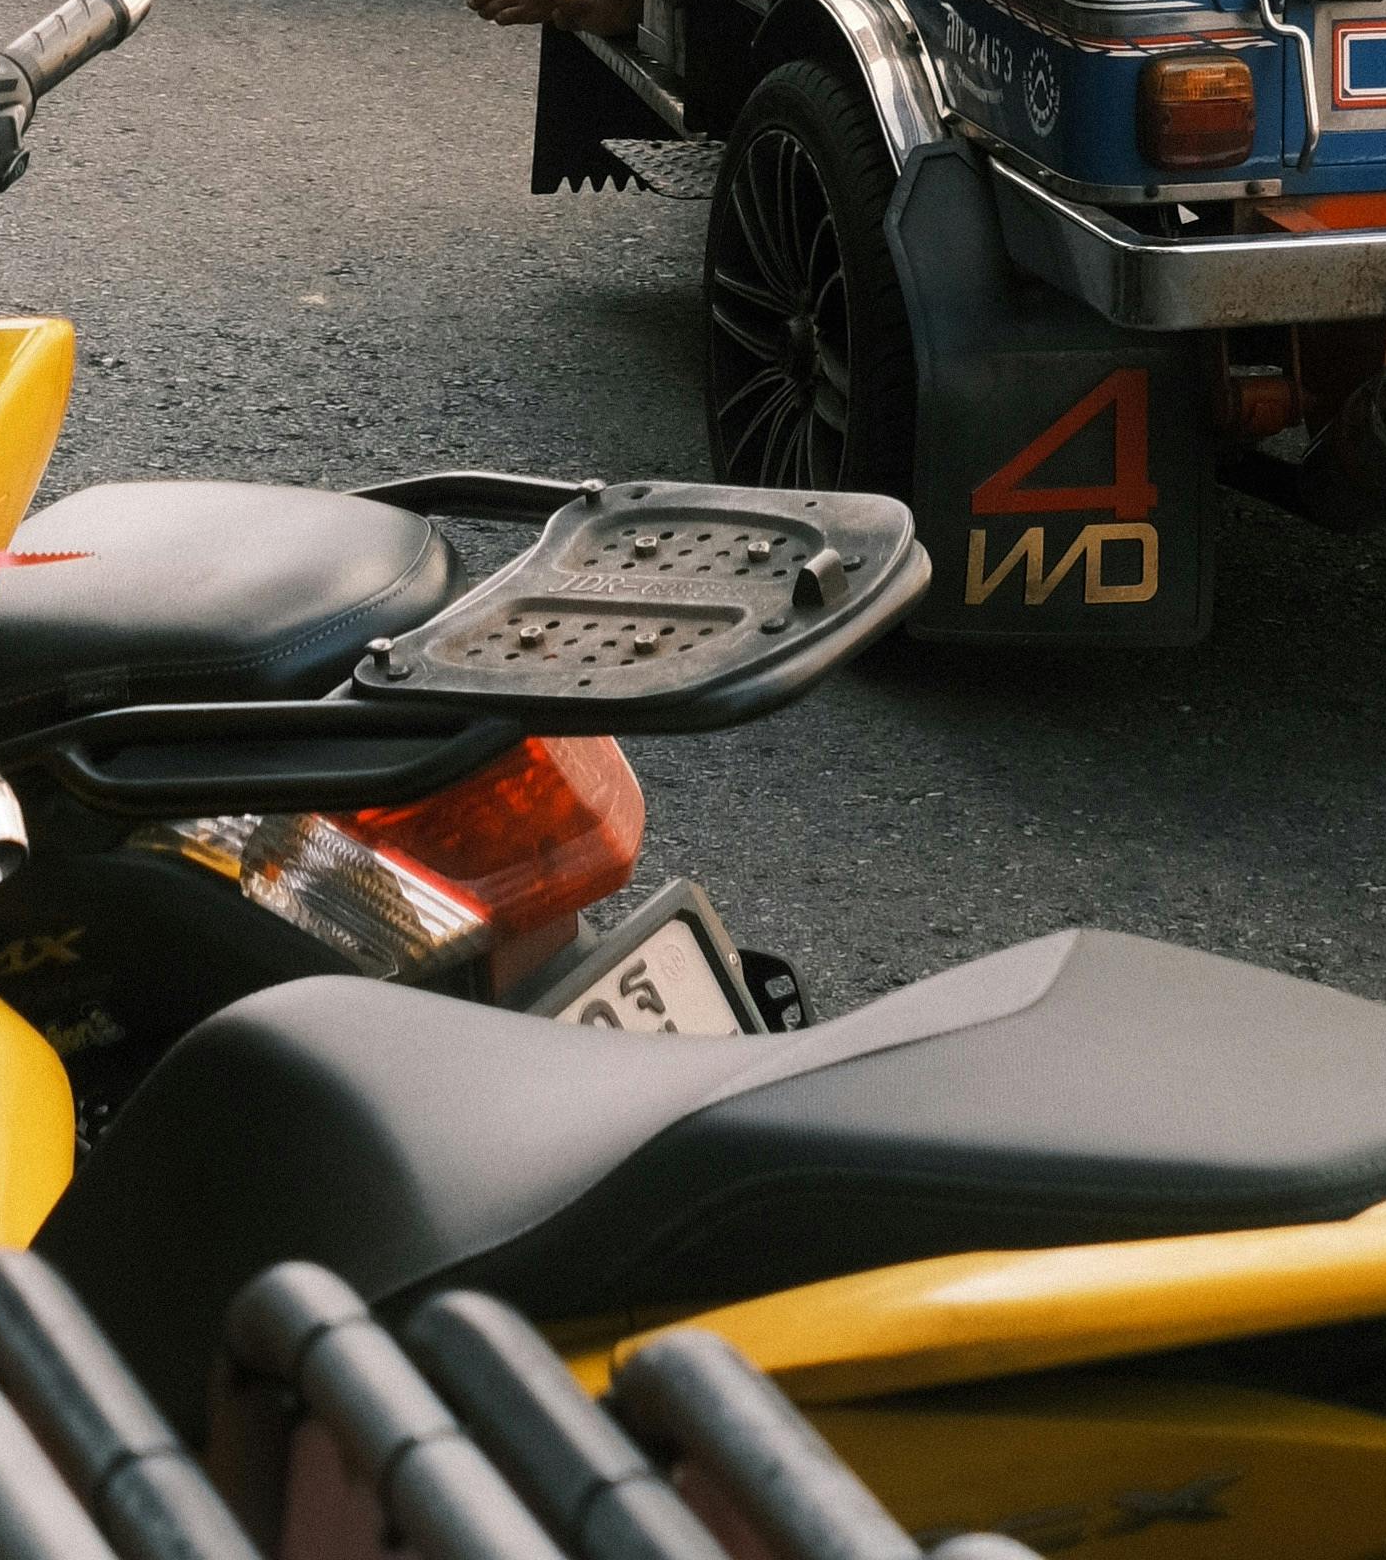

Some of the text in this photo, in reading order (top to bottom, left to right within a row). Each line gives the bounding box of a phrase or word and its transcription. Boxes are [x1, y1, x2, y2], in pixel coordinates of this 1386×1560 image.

[967, 25, 1013, 84] 2453
[971, 368, 1159, 520] 4
[964, 522, 1160, 605] WD
